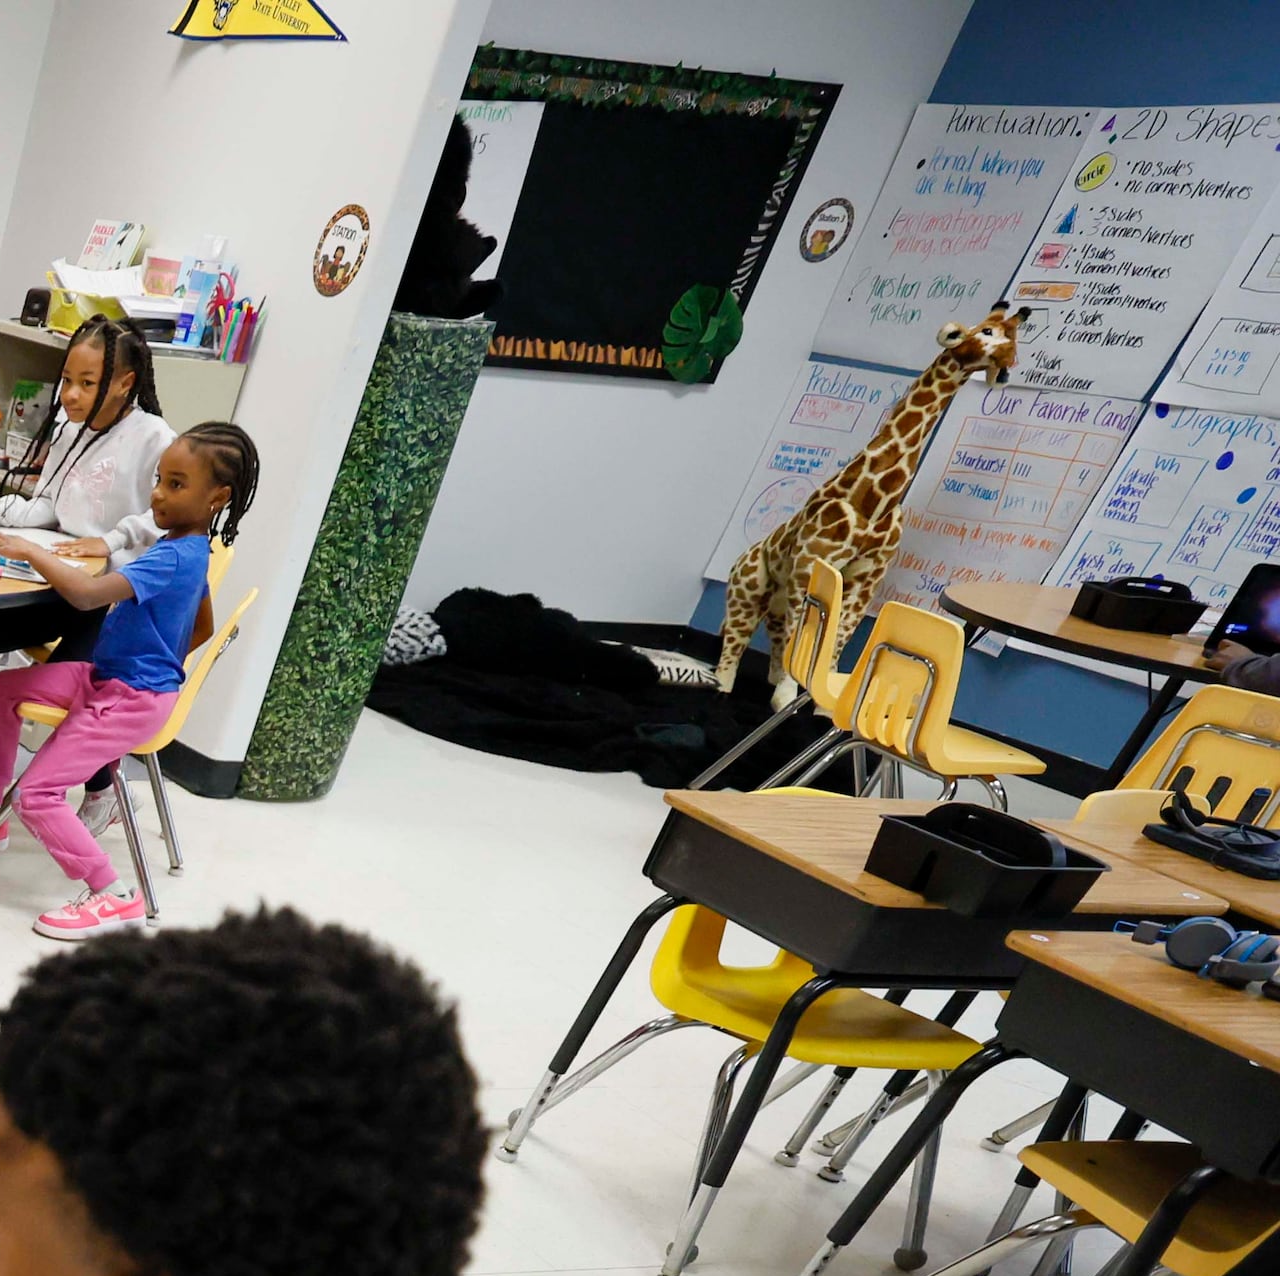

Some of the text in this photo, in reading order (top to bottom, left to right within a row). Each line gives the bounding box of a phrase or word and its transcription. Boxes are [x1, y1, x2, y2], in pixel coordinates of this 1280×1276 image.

[277, 0, 302, 12] ALLEY
[1122, 109, 1168, 140] 2D
[1021, 158, 1045, 186] you
[1131, 161, 1150, 176] no
[1123, 180, 1142, 193] no
[806, 364, 868, 399] Problem
[981, 388, 1022, 416] Our
[1028, 390, 1089, 424] Favorite
[951, 451, 1007, 473] Starburst
